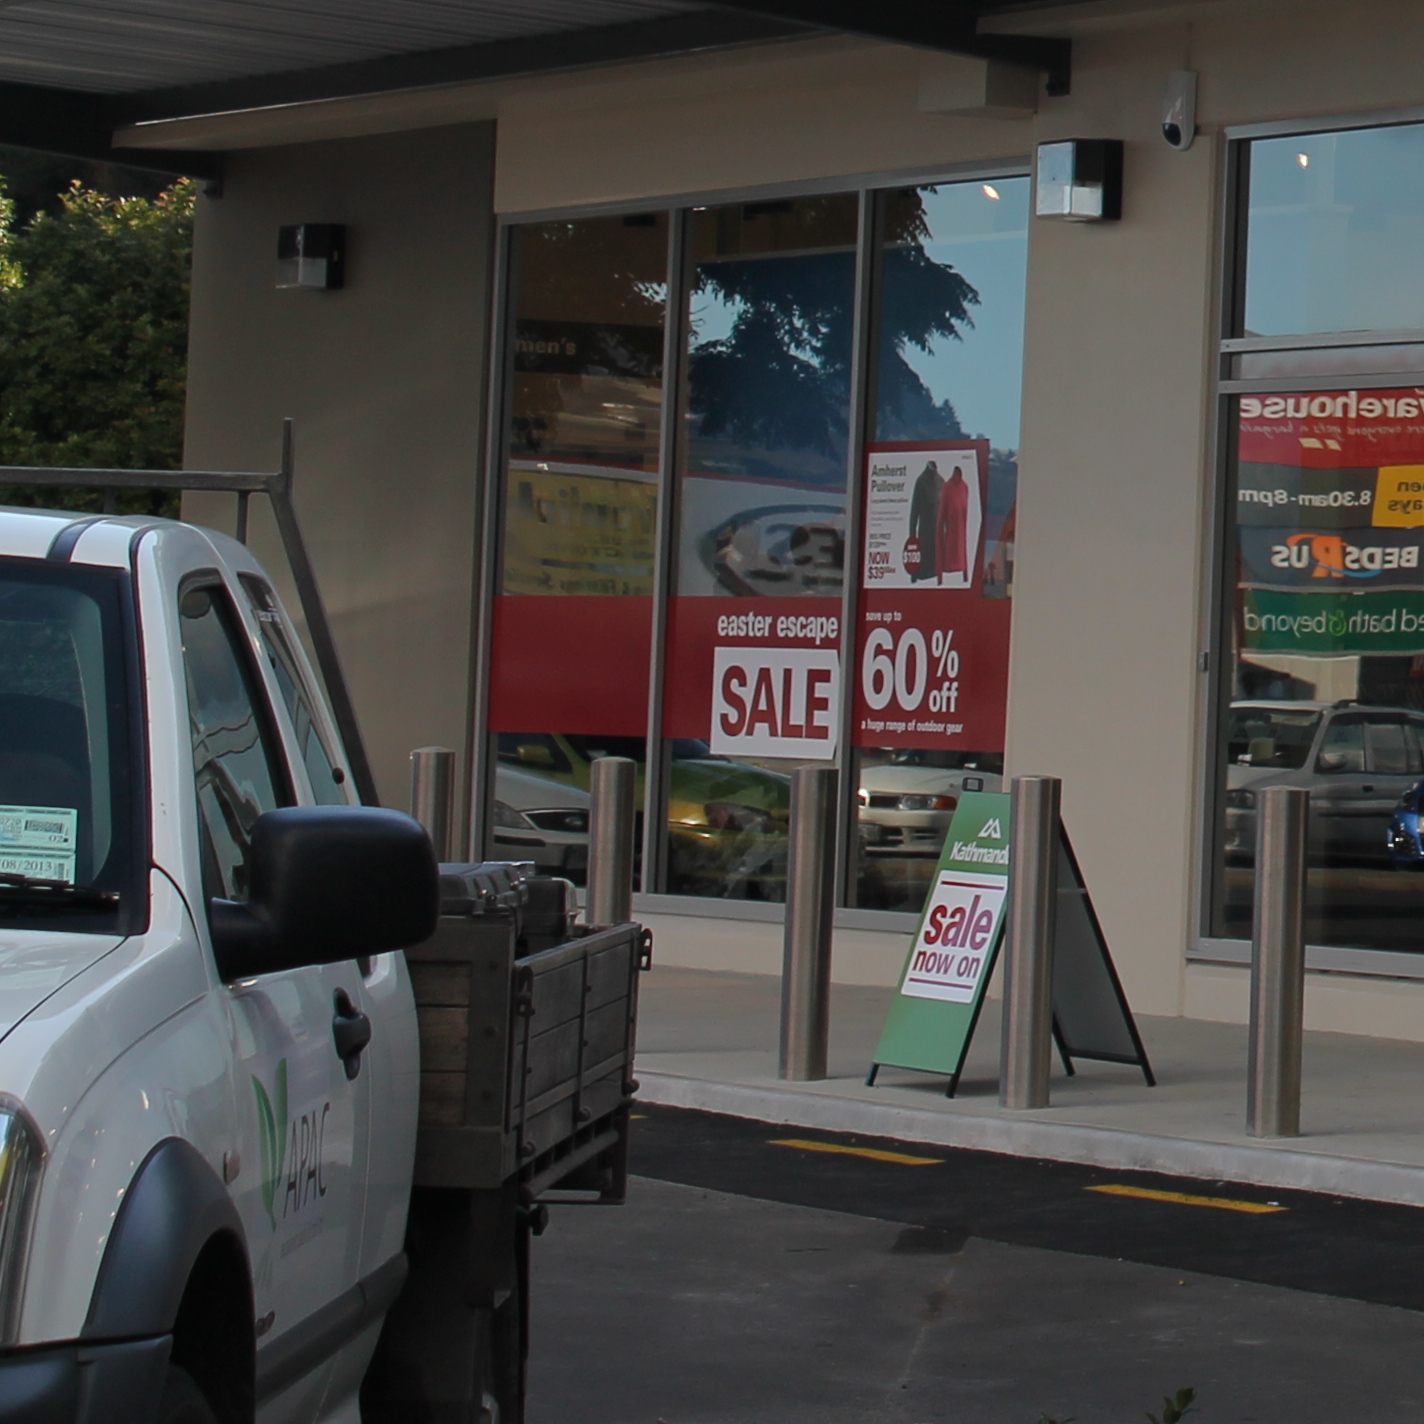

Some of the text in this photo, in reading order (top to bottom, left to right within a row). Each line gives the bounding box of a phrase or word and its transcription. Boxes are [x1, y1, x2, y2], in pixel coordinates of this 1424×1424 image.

[871, 480, 906, 492] Pullover
[868, 552, 890, 564] NOW
[718, 611, 838, 645] easter escape
[866, 611, 902, 623] save up to
[720, 664, 832, 740] SALE
[929, 681, 959, 712] off
[867, 718, 885, 732] huge
[886, 721, 906, 734] range
[907, 719, 916, 730] of
[916, 720, 945, 732] outdoor
[946, 723, 963, 735] gear
[949, 840, 1009, 865] Kathmand
[924, 894, 993, 951] sale
[912, 949, 981, 979] now on
[283, 1101, 331, 1219] APAC
